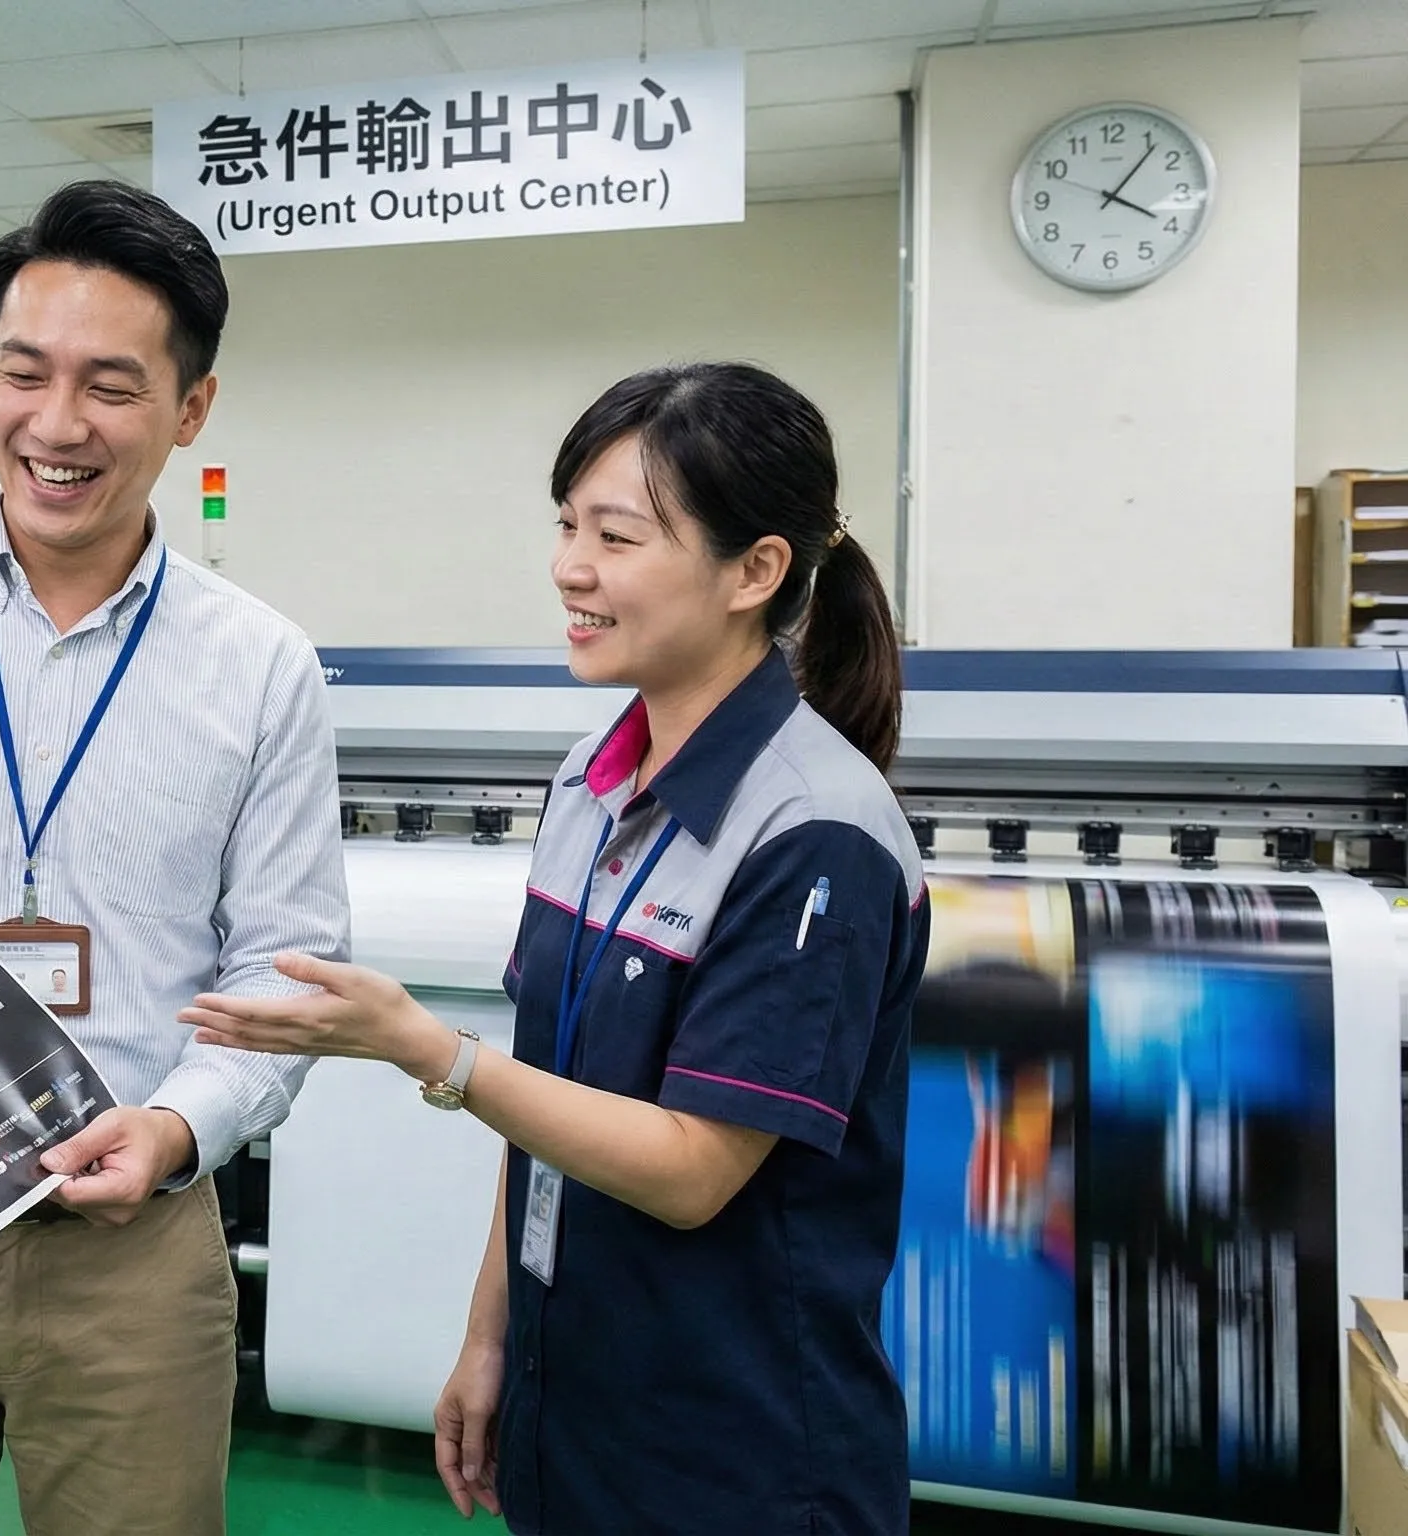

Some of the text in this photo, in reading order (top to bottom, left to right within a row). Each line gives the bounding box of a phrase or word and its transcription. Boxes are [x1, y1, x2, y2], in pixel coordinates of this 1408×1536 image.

[198, 77, 692, 187] 急件輸出中心
[1099, 122, 1125, 144] 12
[1142, 130, 1152, 149] 1
[1066, 136, 1087, 155] 11
[1044, 159, 1068, 180] 10
[1164, 150, 1180, 171] 2
[1034, 191, 1050, 211] 9
[1174, 182, 1191, 201] 3
[215, 168, 671, 239] (Urgent Output Center)
[1043, 222, 1060, 242] 8
[1162, 216, 1179, 233] 4
[1069, 244, 1086, 263] 7
[1137, 241, 1154, 260] 5
[1102, 251, 1119, 270] 6
